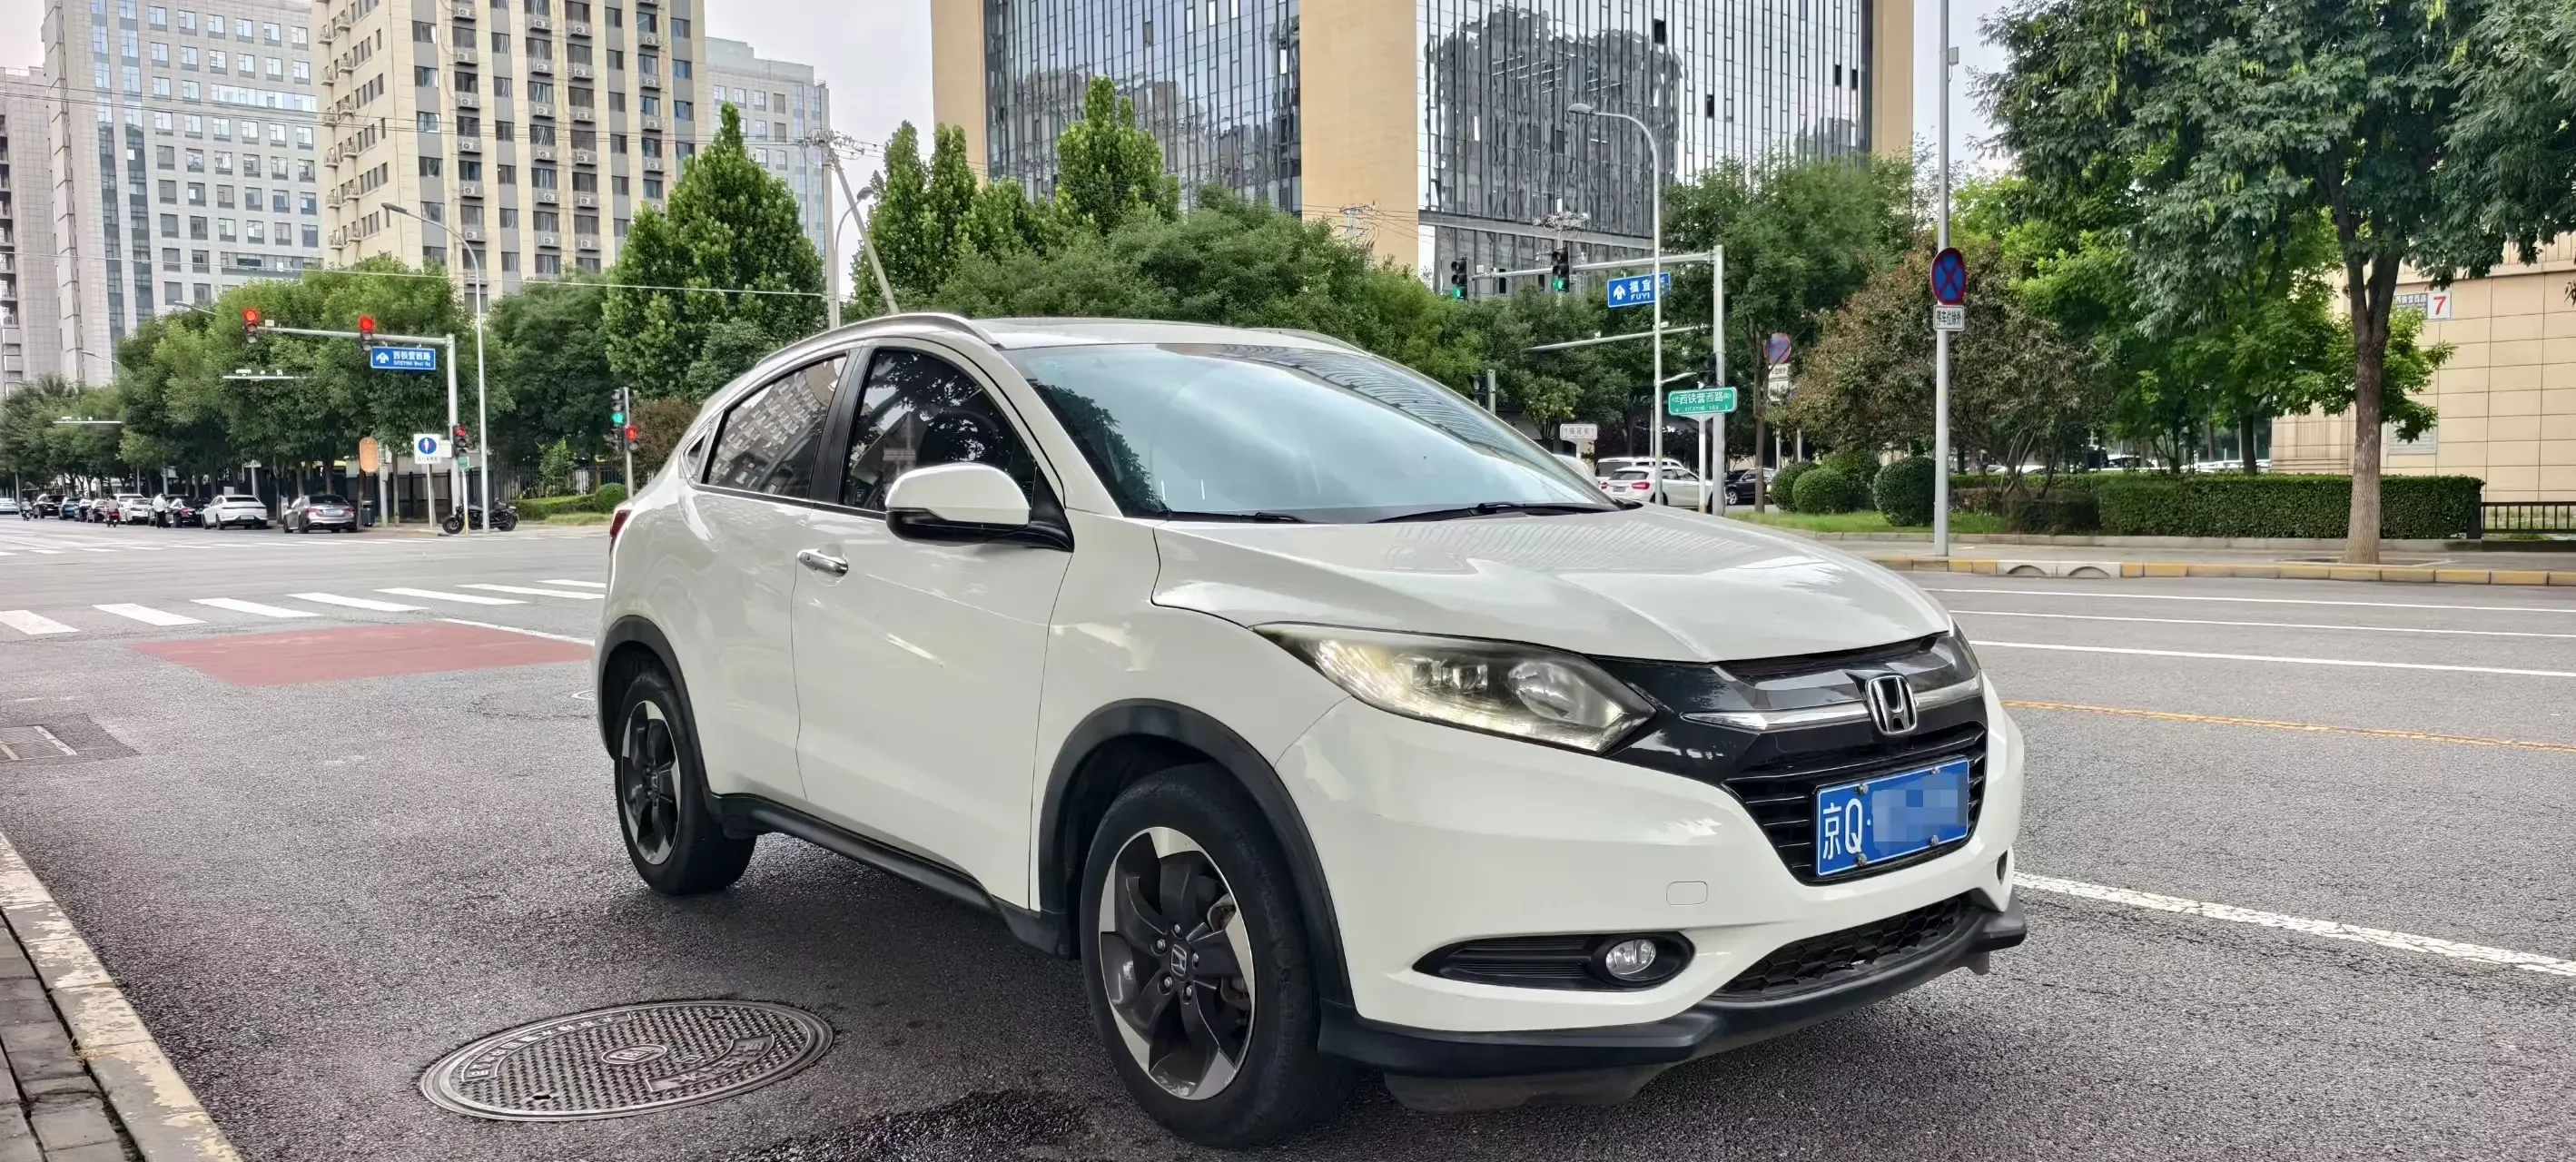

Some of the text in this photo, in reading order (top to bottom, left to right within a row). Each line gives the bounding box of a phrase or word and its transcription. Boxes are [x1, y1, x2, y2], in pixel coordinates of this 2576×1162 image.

[1631, 292, 1650, 300] FUYI
[2433, 296, 2446, 315] 7
[393, 351, 431, 360] 西铁营西路
[1680, 391, 1723, 405] 西铁营西路
